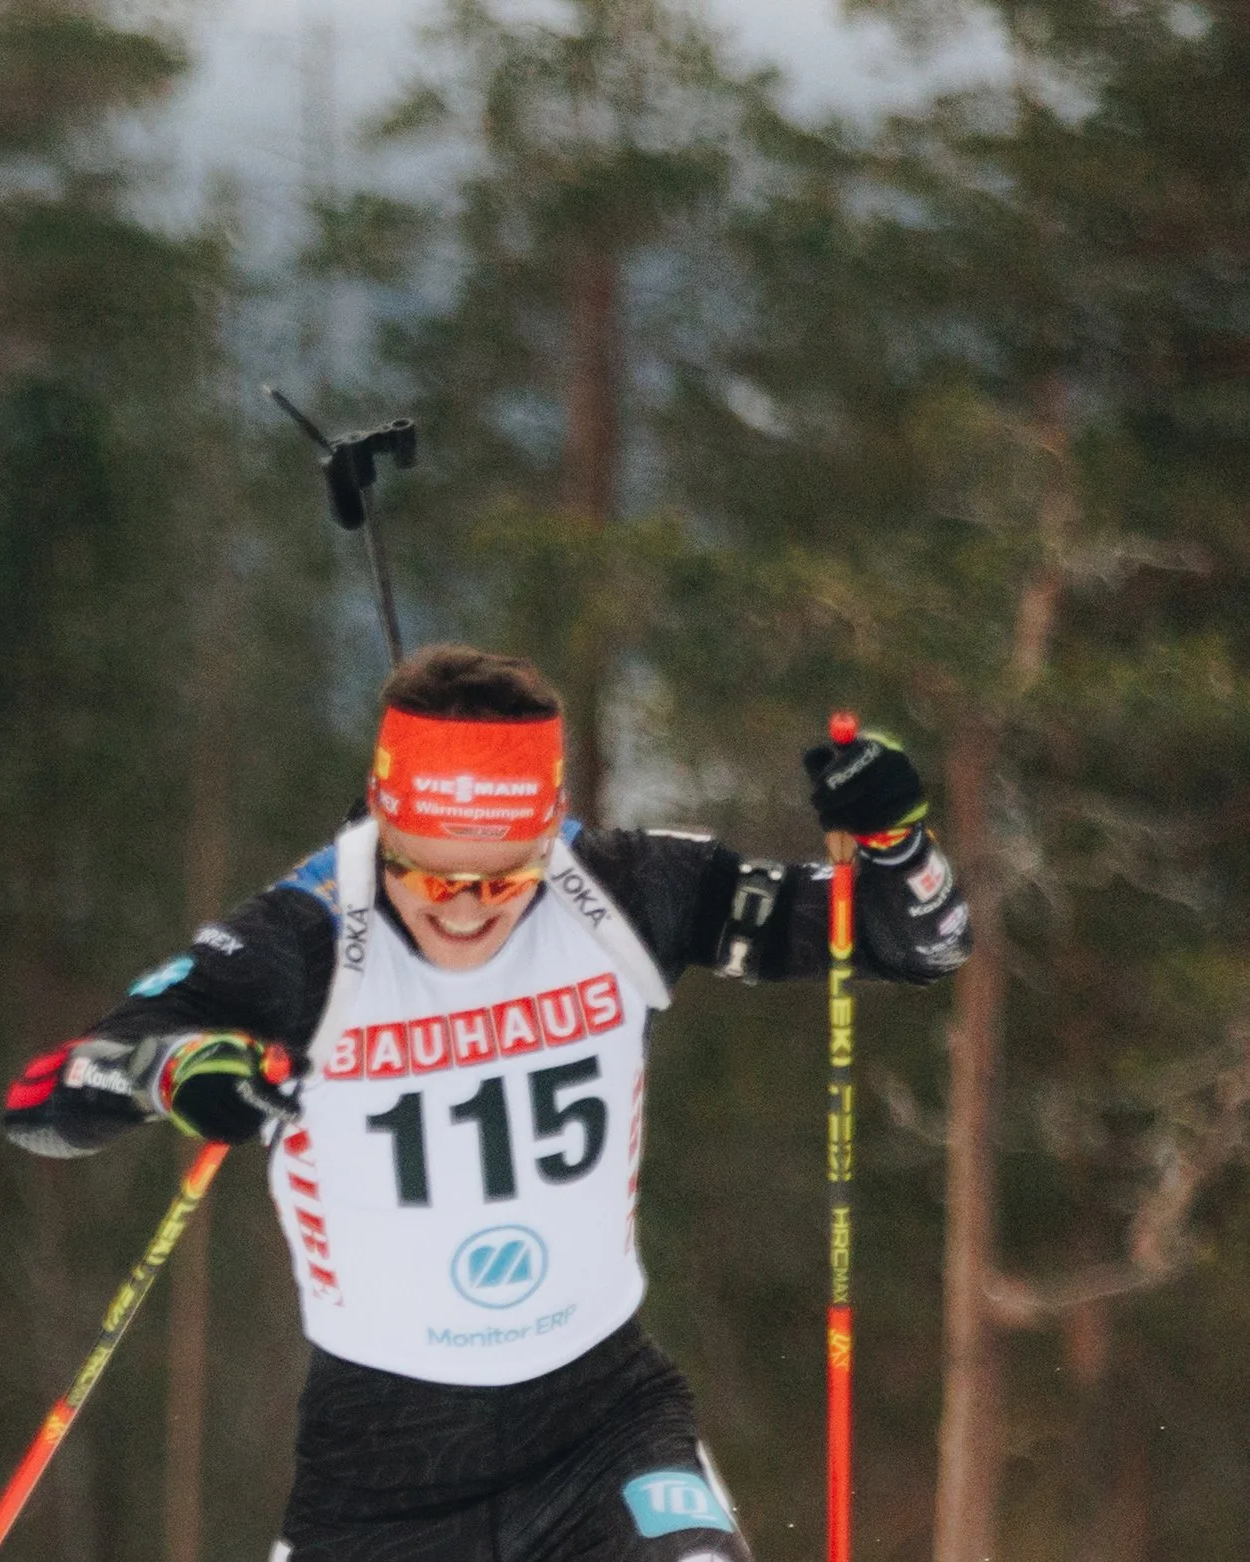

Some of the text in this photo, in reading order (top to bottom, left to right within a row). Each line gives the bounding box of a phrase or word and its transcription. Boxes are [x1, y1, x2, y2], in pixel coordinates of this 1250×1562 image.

[552, 867, 607, 929] JOKA
[343, 907, 369, 974] JOKA
[326, 975, 623, 1078] BAUHAUS
[365, 1055, 609, 1209] 115
[427, 1303, 578, 1348] Monitor ERP
